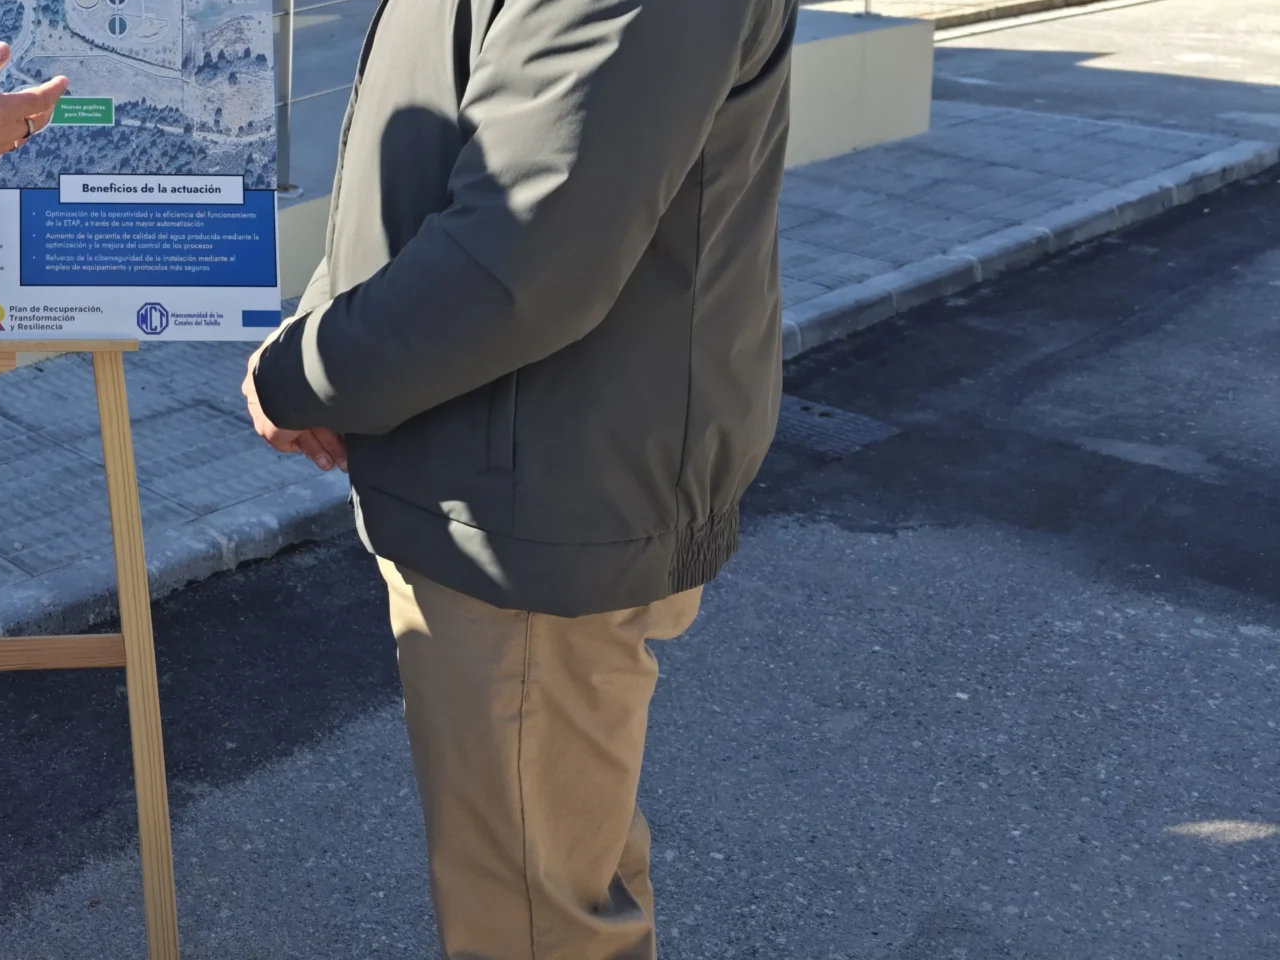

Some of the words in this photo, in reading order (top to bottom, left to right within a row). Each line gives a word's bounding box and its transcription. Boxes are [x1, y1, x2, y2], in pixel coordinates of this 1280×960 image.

[82, 182, 138, 193] Beneficios
[140, 183, 154, 193] de
[158, 183, 167, 194] la
[170, 184, 222, 194] actuación
[45, 210, 89, 218] Optimización
[108, 210, 148, 219] operatividad
[162, 210, 194, 218] eficiencia
[207, 211, 257, 219] funcionamiento
[64, 220, 83, 228] ETAP,
[156, 220, 204, 228] automatización
[45, 232, 75, 240] Aumento
[76, 232, 86, 240] de
[94, 232, 120, 241] garantía
[122, 232, 131, 240] de
[132, 232, 156, 240] calidad
[157, 232, 168, 240] del
[170, 234, 185, 242] agua
[187, 233, 220, 241] producida
[45, 241, 87, 250] optimización
[102, 242, 124, 250] mejora
[94, 254, 143, 263] ciberseguridad
[45, 263, 70, 272] empleo
[82, 264, 127, 272] equipamiento
[134, 264, 168, 272] protocolos
[184, 265, 210, 273] seguros
[9, 305, 28, 313] Plan
[29, 305, 41, 313] de
[43, 305, 104, 314] Recuperación,
[9, 314, 76, 322] Transformación
[139, 305, 167, 333] MCT
[10, 324, 15, 332] y
[18, 323, 63, 331] Resiliencia
